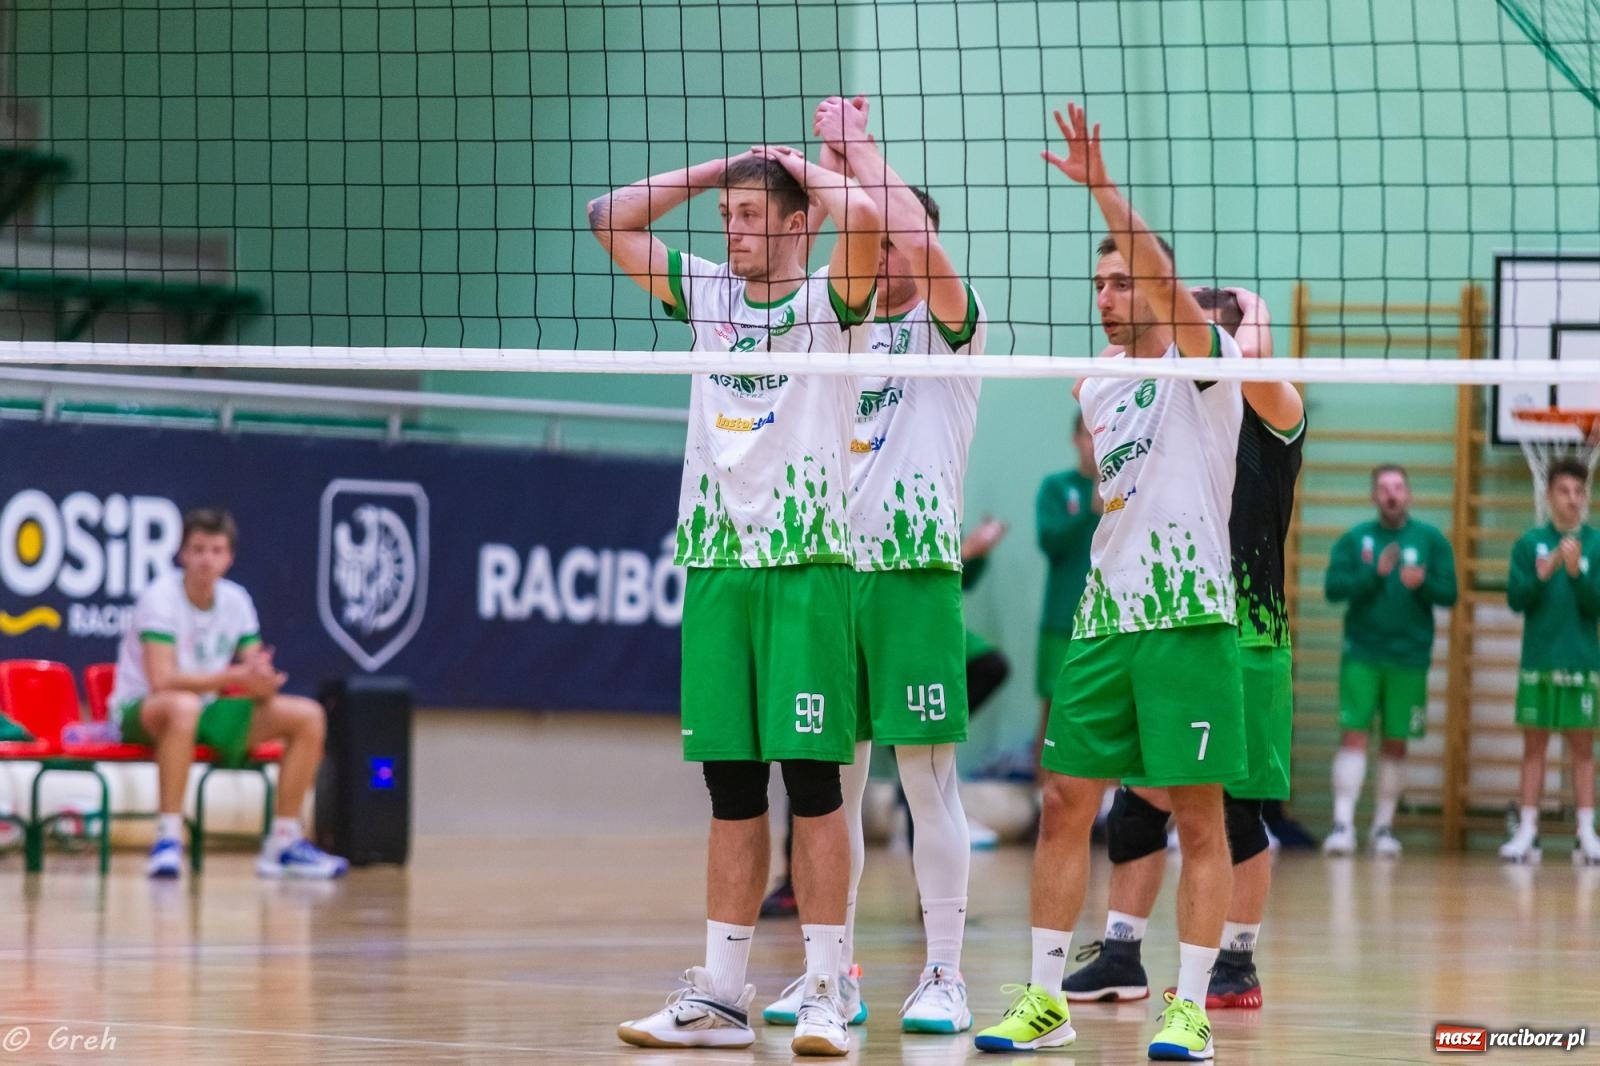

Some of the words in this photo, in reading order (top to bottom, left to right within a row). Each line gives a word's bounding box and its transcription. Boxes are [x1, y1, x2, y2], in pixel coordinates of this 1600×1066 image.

[0, 489, 183, 597] OSiR
[795, 692, 824, 734] 99
[906, 683, 946, 721] 49
[1190, 721, 1211, 761] 7
